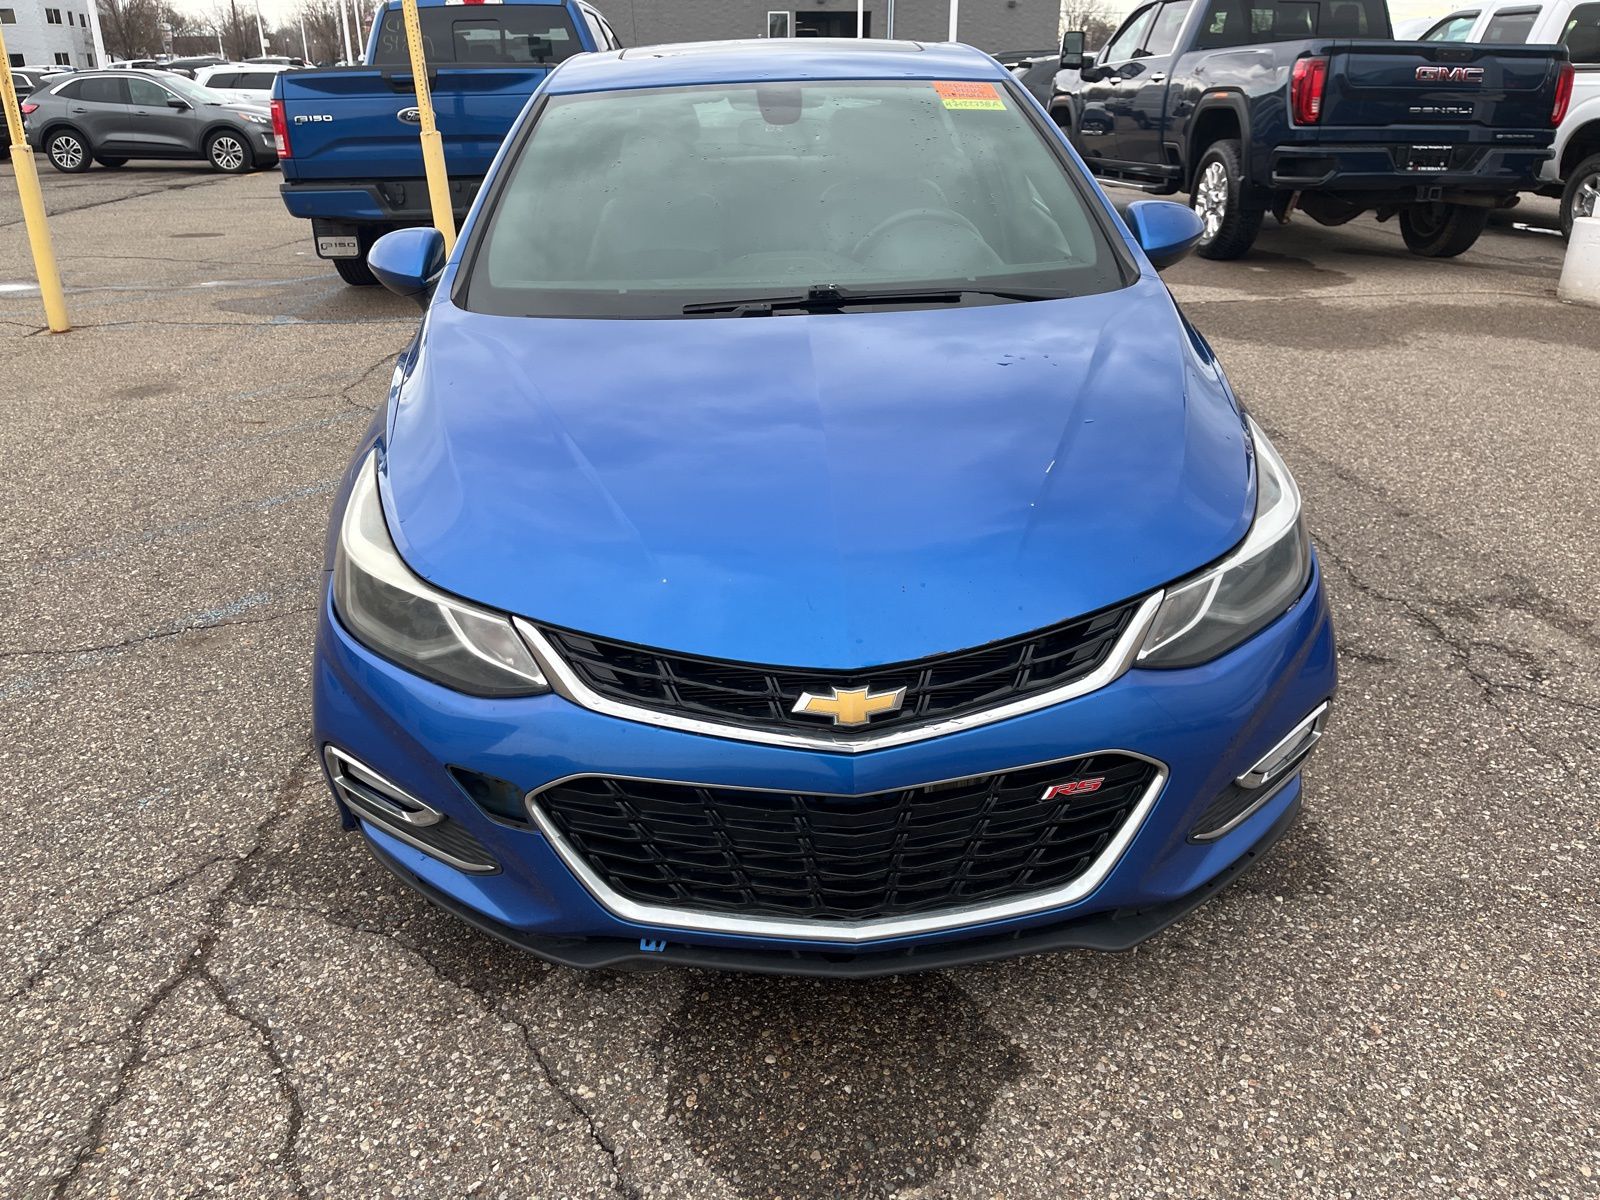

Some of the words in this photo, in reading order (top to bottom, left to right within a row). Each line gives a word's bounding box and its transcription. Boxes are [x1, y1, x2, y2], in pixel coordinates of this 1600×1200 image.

[1415, 66, 1485, 83] GMC
[1409, 106, 1473, 114] DENALI
[1041, 777, 1106, 801] RS
